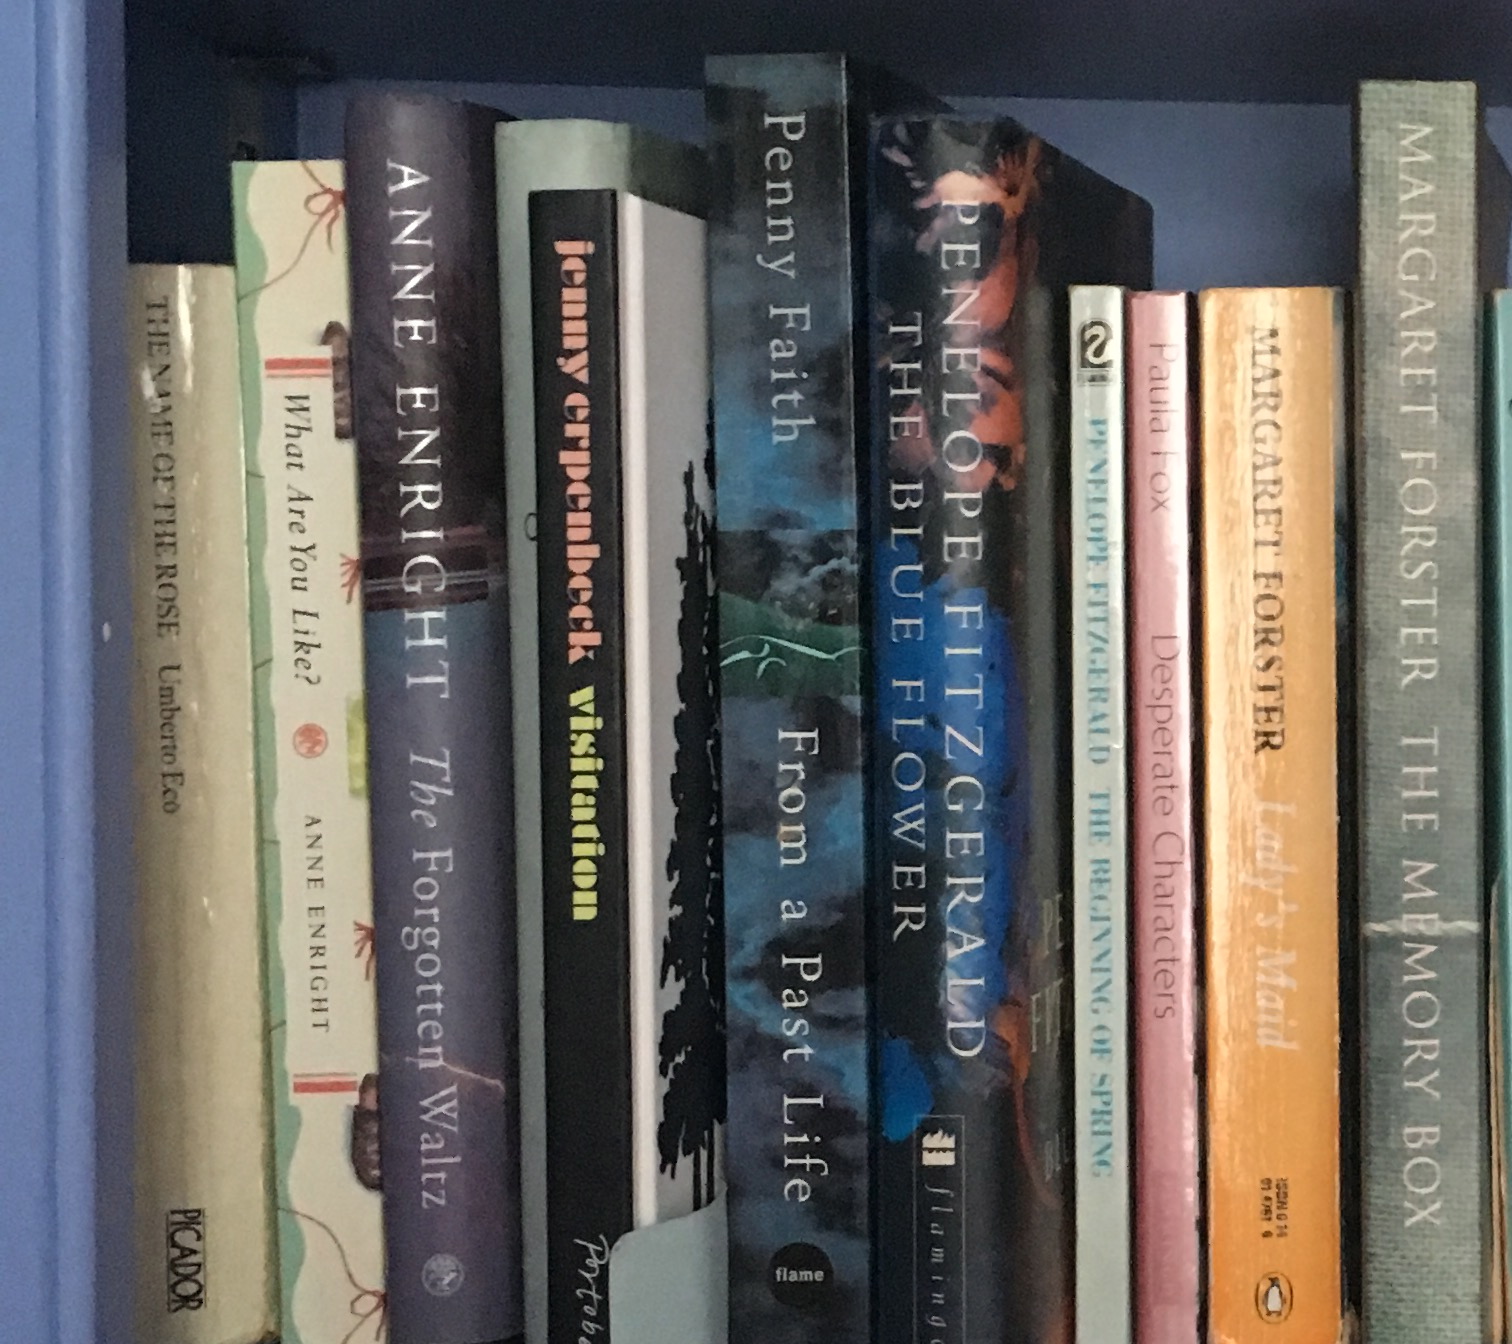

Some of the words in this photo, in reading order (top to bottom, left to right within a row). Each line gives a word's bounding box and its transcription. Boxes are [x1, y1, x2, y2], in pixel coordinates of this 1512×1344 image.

[386, 158, 439, 348] ANNE
[756, 111, 808, 281] Penny
[552, 238, 596, 385] jenny
[1398, 122, 1440, 416] MARGARET
[280, 393, 315, 472] What
[768, 303, 818, 447] Faith
[889, 310, 925, 443] THE
[940, 197, 984, 565] PENELOPE
[1146, 342, 1180, 434] Paula
[285, 482, 319, 533] Are
[394, 384, 451, 699] ENRIGHT
[557, 392, 602, 666] erpenbeck
[1149, 450, 1180, 513] Fox
[286, 542, 319, 592] You
[889, 480, 925, 644] BLUE
[1400, 449, 1441, 689] FORSTER
[288, 608, 321, 686] Like?
[408, 744, 454, 829] The
[776, 726, 821, 869] From
[1146, 636, 1186, 816] Desperate
[1400, 725, 1440, 834] THE
[569, 684, 606, 920] visitation
[891, 678, 927, 943] FLOWER
[941, 603, 987, 1059] FITZGERALD
[401, 847, 453, 1069] Forgotten
[780, 898, 807, 922] a
[1150, 831, 1187, 1020] Characters
[1400, 858, 1441, 1101] MEMORY
[780, 952, 824, 1064] Past
[418, 1083, 462, 1210] Waltz
[783, 1094, 830, 1203] Life
[1401, 1125, 1442, 1230] BOX
[168, 1207, 203, 1313] PICADOR
[776, 1265, 825, 1284] flame
